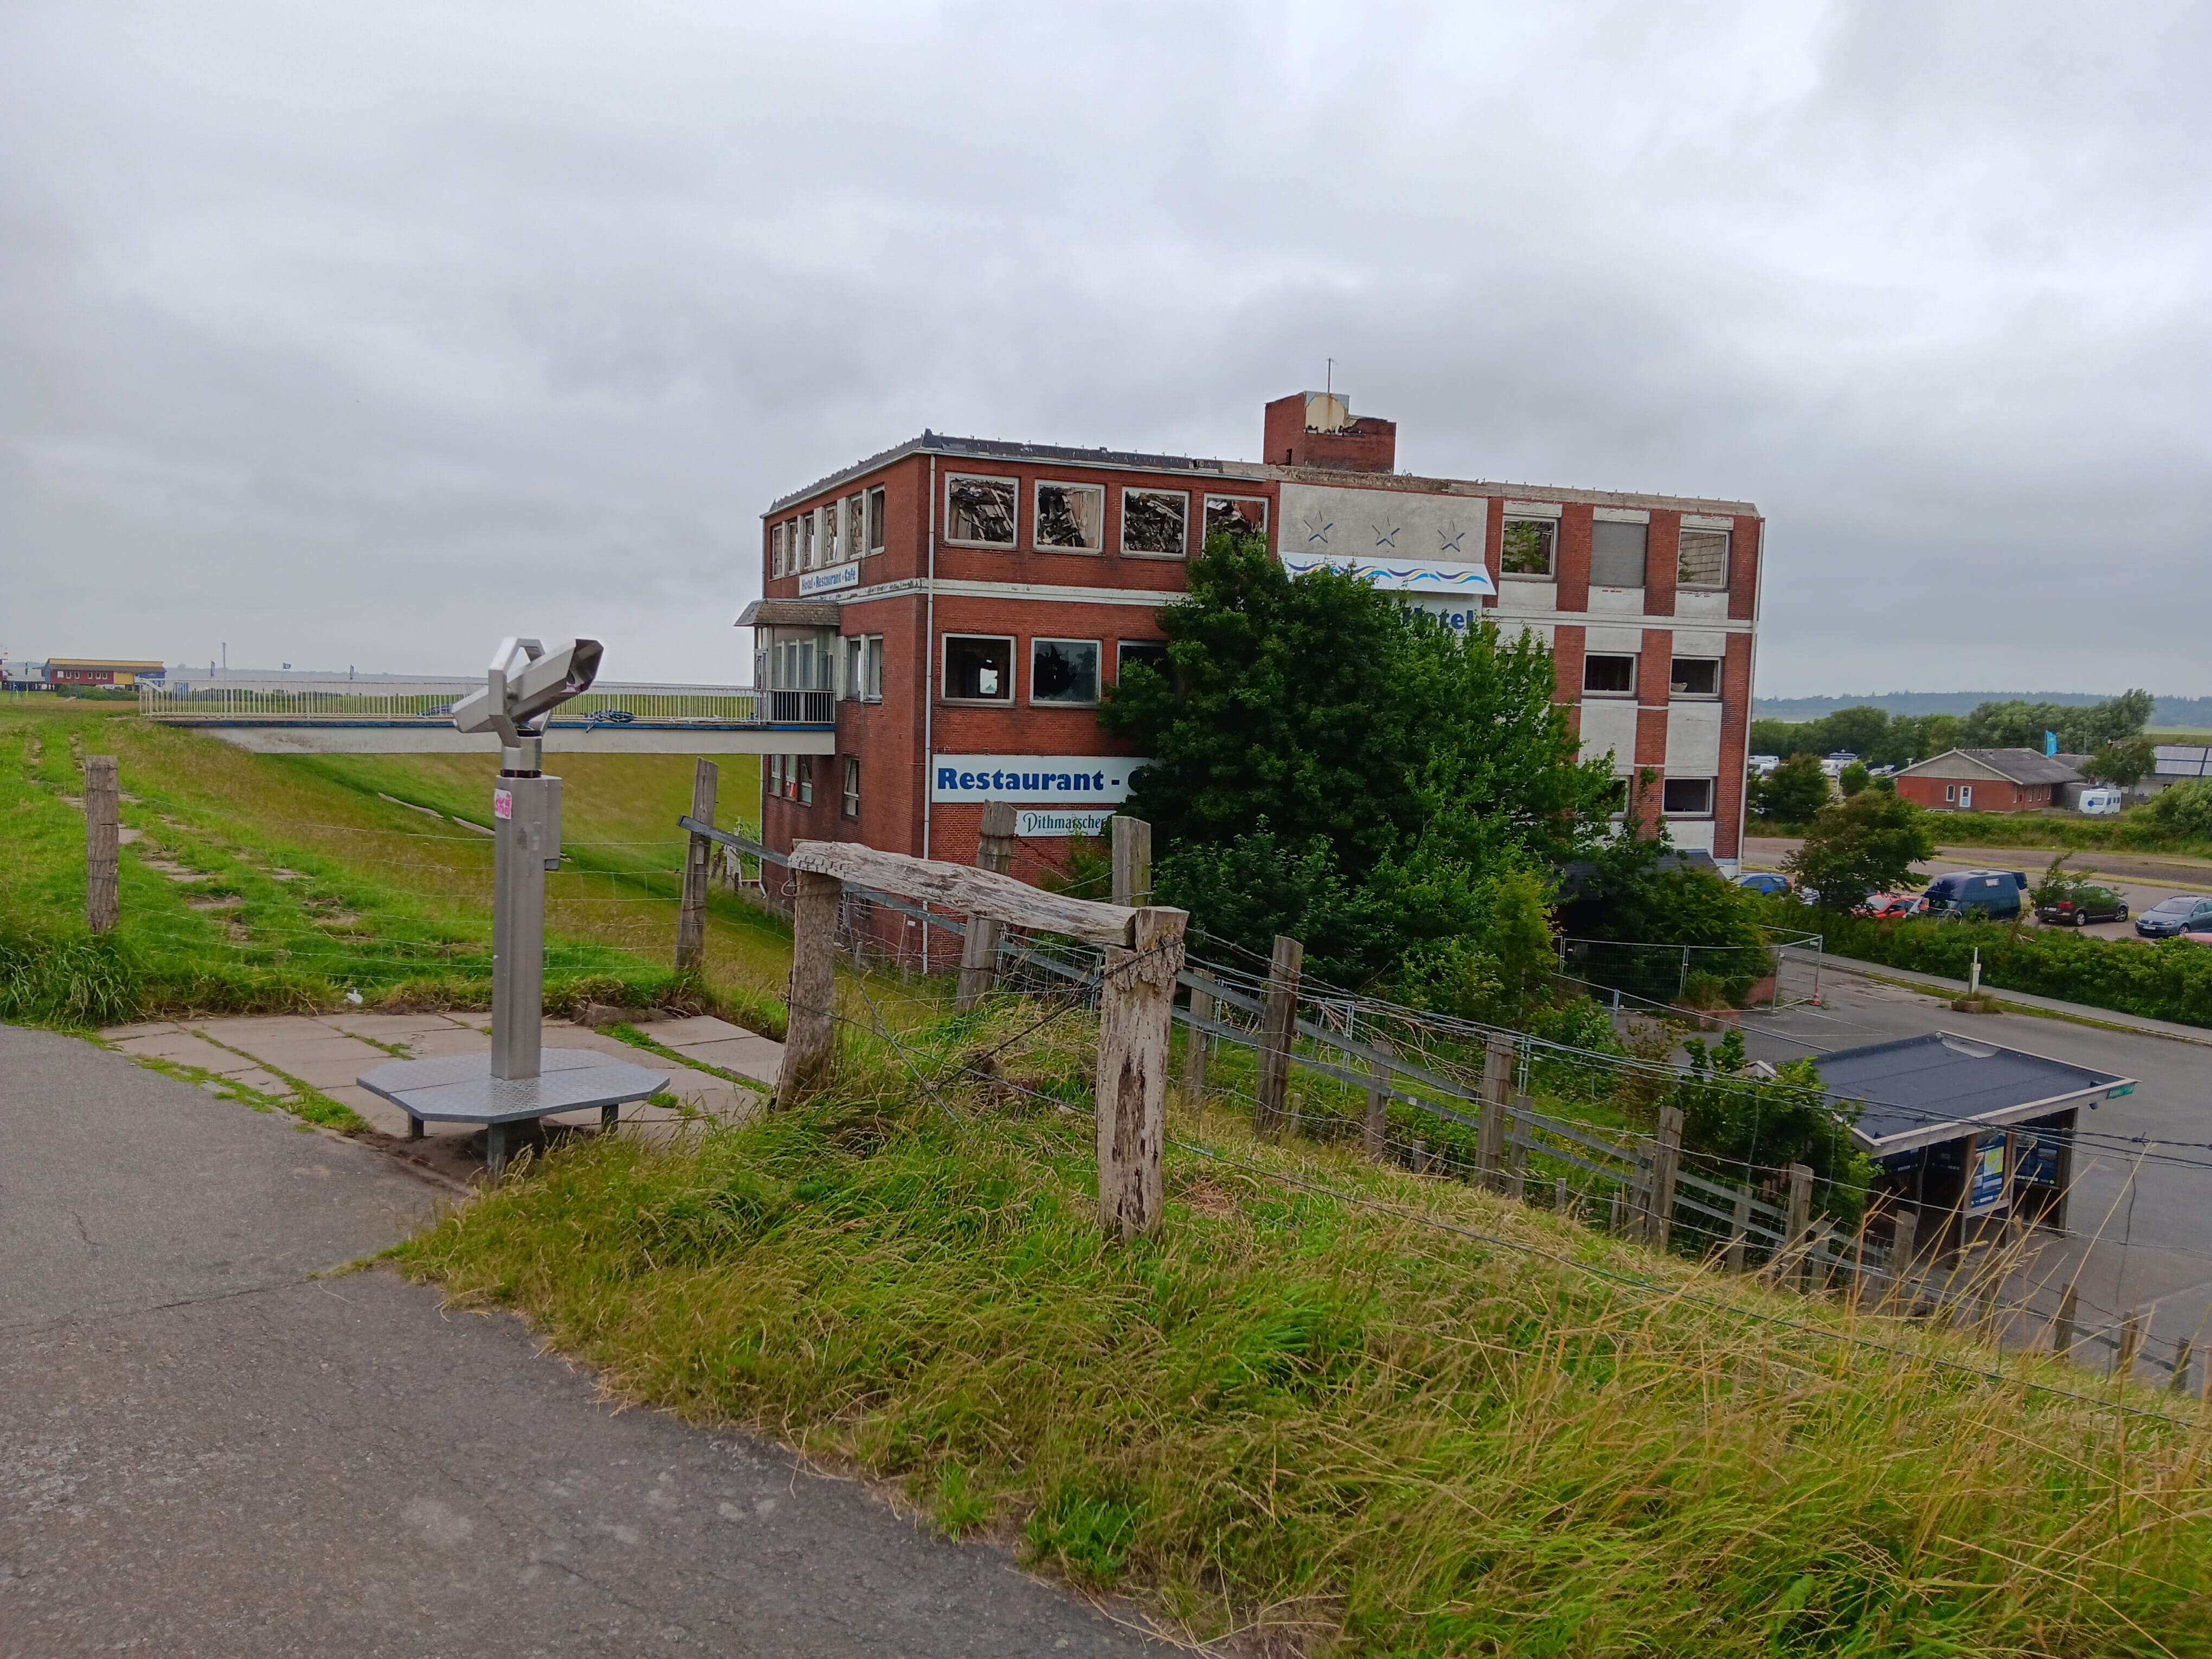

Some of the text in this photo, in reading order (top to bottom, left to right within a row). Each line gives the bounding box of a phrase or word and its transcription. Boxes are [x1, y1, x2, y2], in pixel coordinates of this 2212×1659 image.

[802, 577, 813, 590] Hotel
[816, 571, 841, 588] Restaurant
[937, 768, 1104, 790] Restaurant
